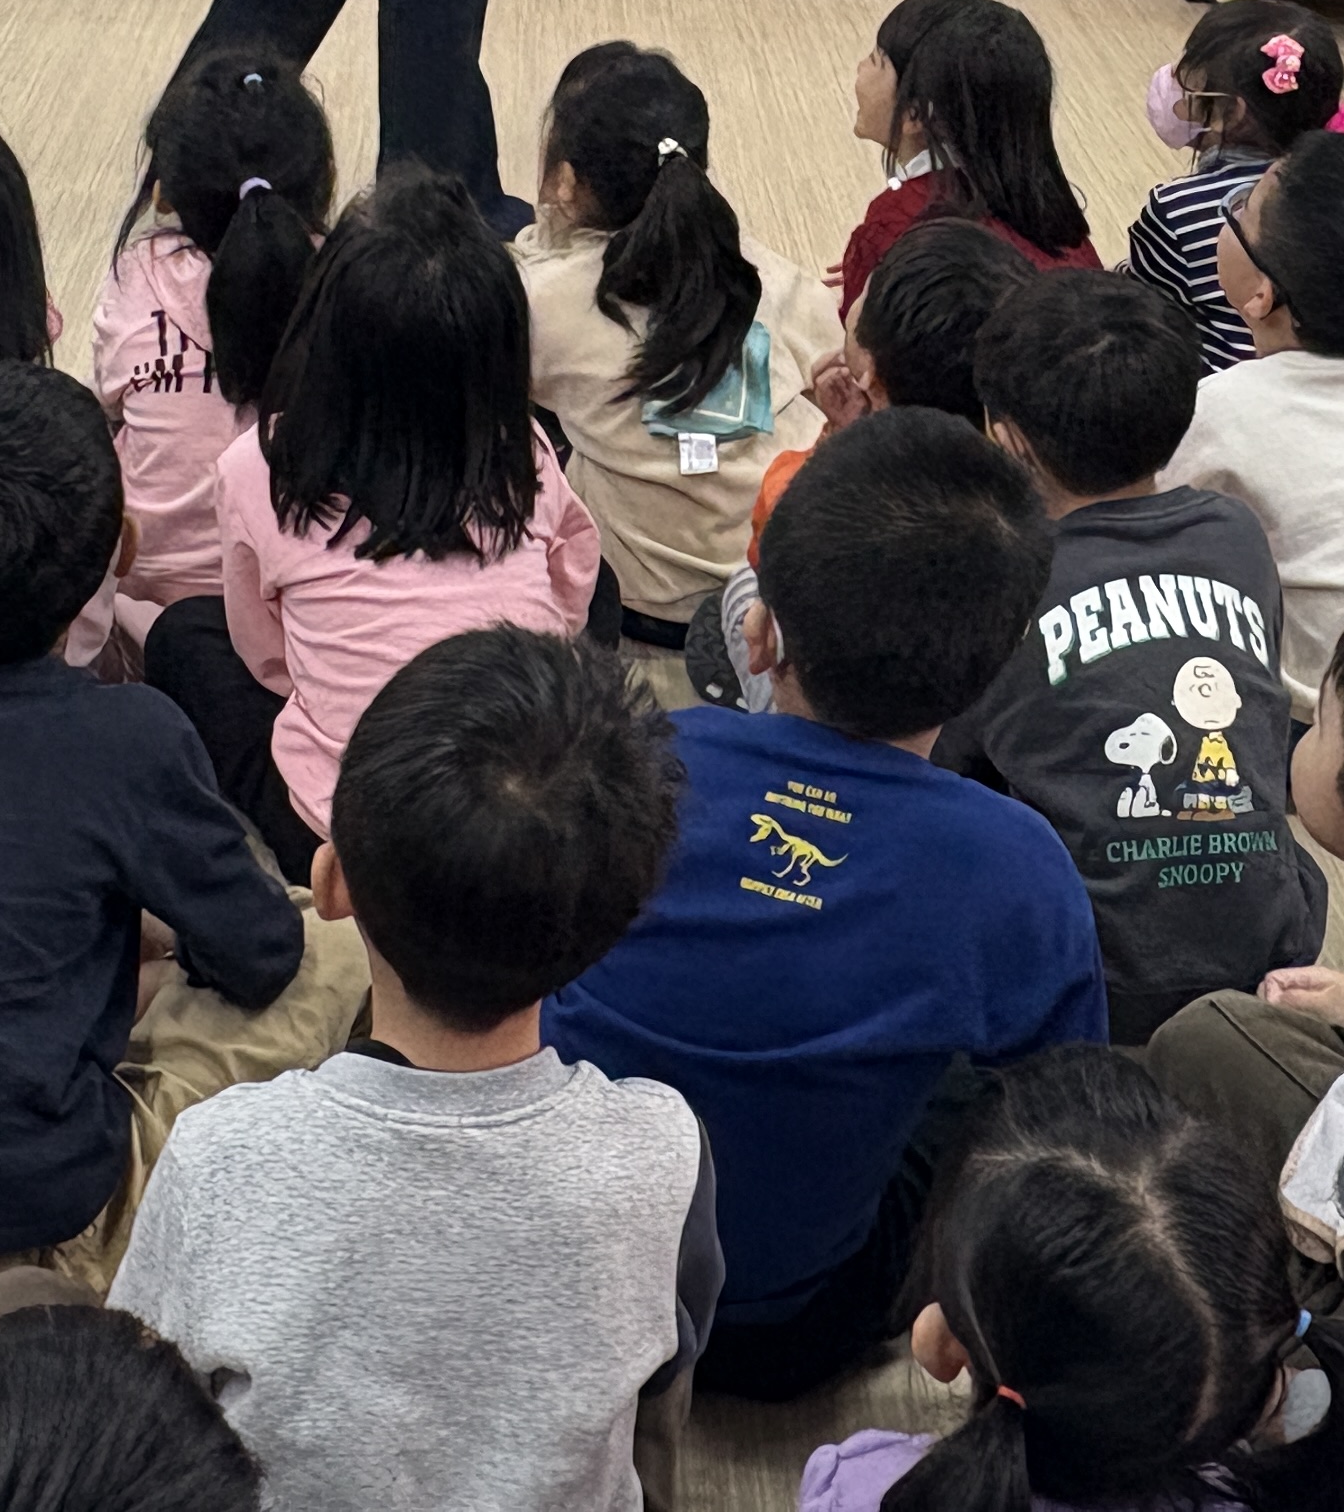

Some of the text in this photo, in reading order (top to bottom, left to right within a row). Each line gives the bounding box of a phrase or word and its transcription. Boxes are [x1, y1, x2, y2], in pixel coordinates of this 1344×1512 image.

[1038, 573, 1270, 686] PEANUTS
[1106, 830, 1278, 863] CHARLIE BROWN
[1158, 862, 1245, 888] SNOOPY
